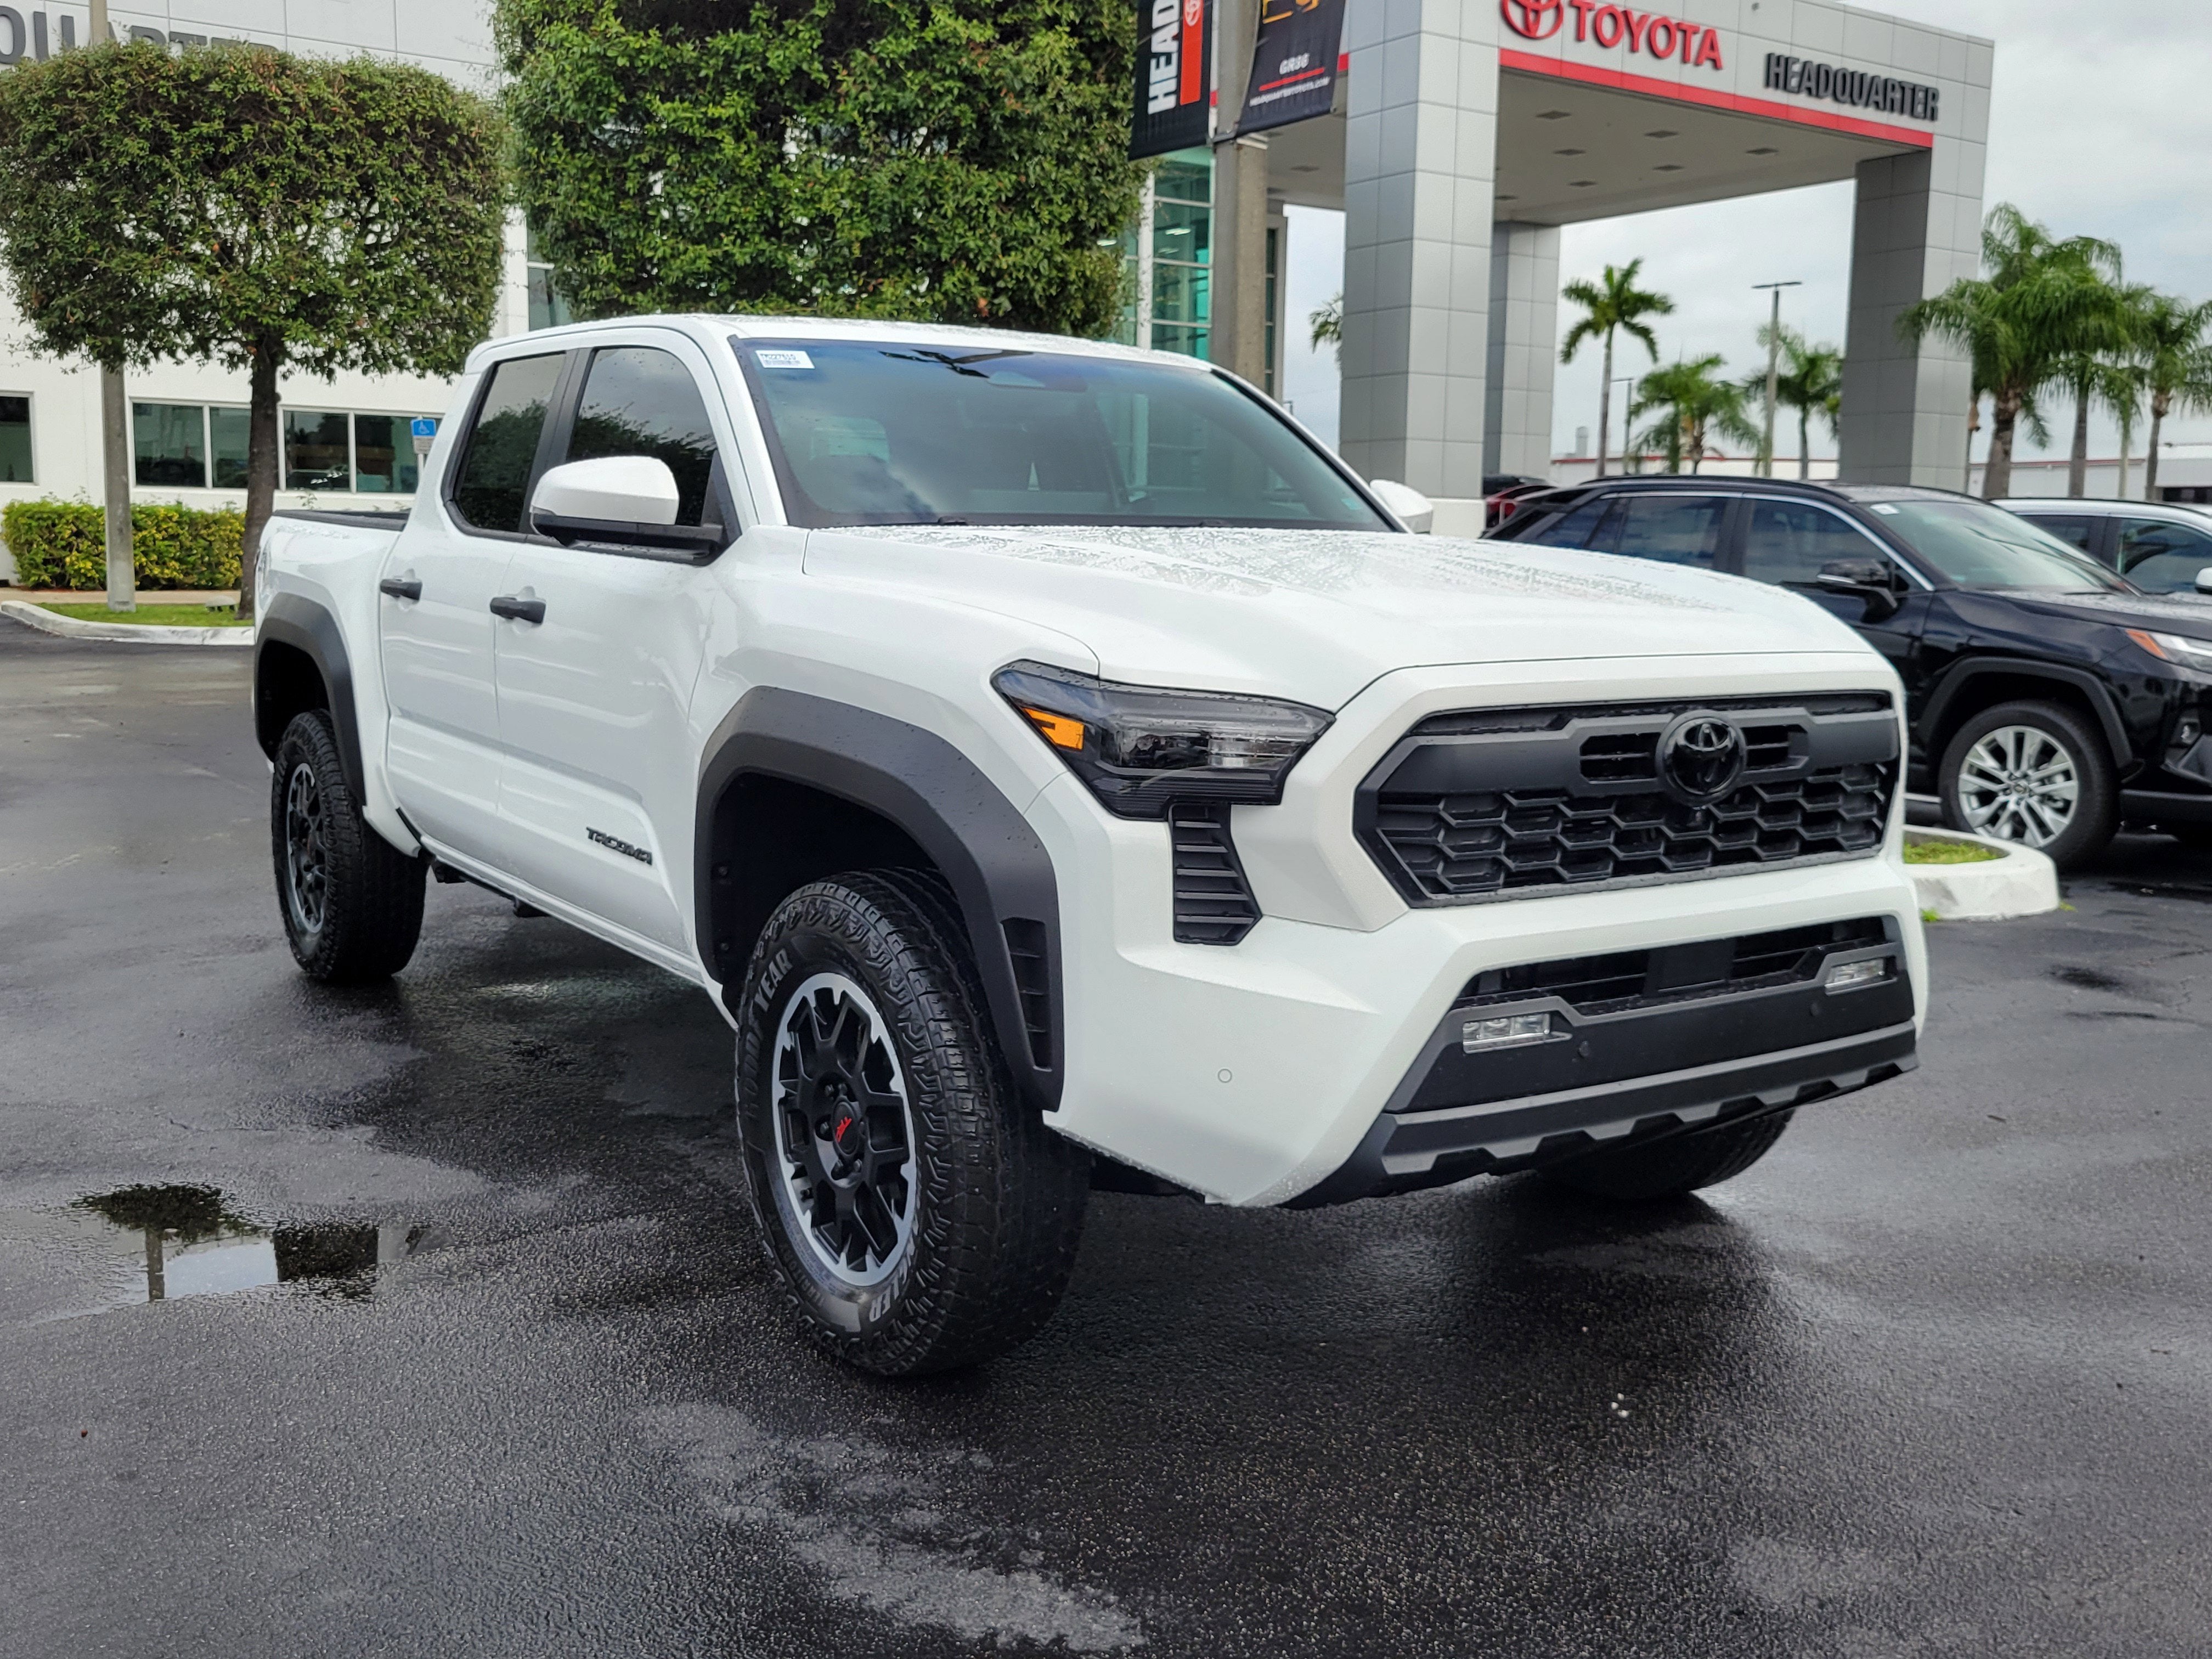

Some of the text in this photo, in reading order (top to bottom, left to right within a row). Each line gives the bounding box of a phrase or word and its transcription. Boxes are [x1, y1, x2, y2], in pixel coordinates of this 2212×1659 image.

[1569, 0, 1939, 122] TOYOTA HEADQUARTER
[586, 826, 653, 865] TACOMA
